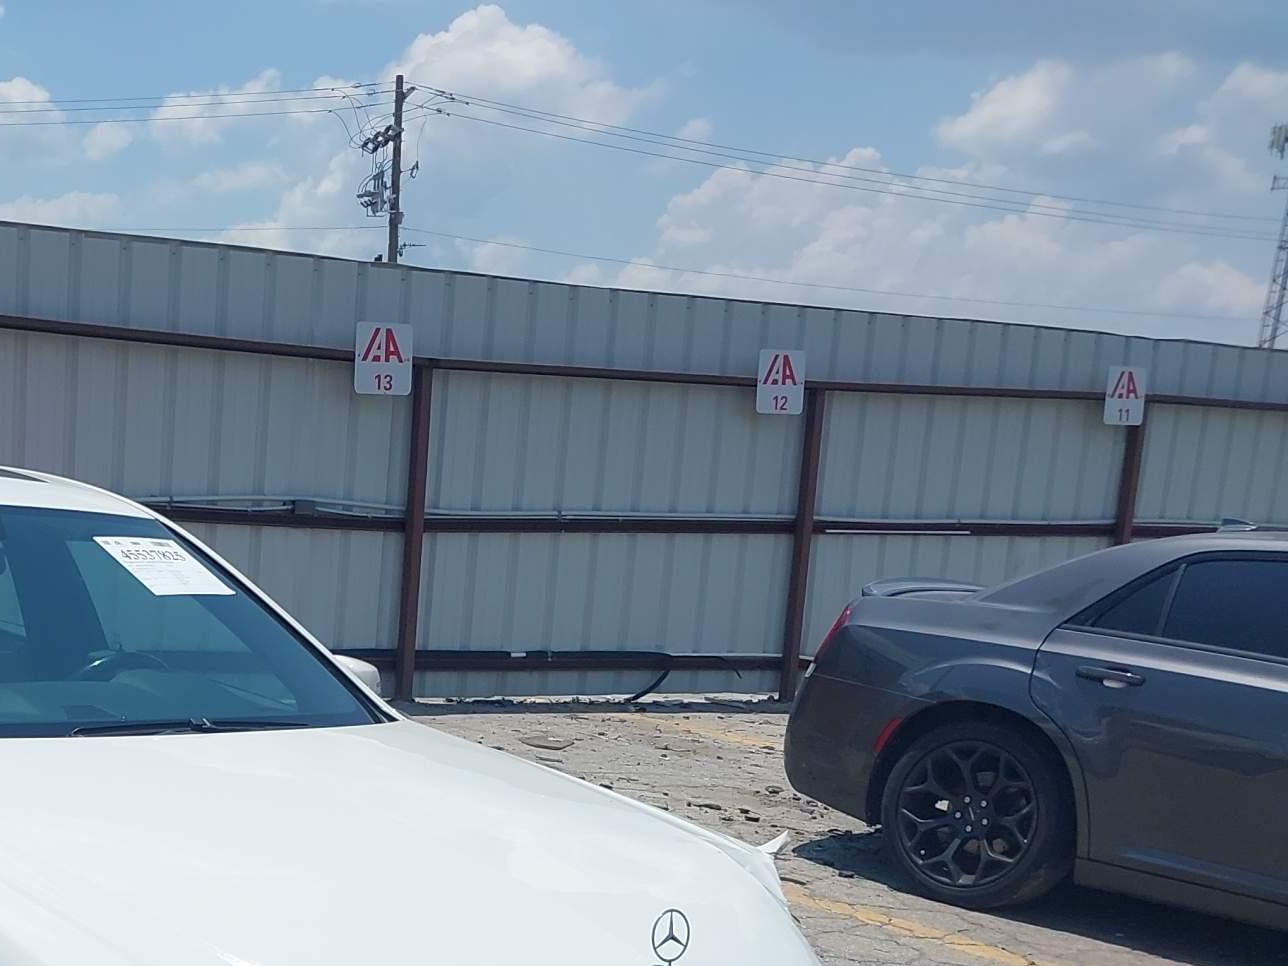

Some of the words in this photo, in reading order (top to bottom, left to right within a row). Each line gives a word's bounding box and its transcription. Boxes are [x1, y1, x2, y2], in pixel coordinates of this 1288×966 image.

[374, 374, 393, 391] 13
[772, 395, 789, 411] 12
[1118, 408, 1130, 422] 11
